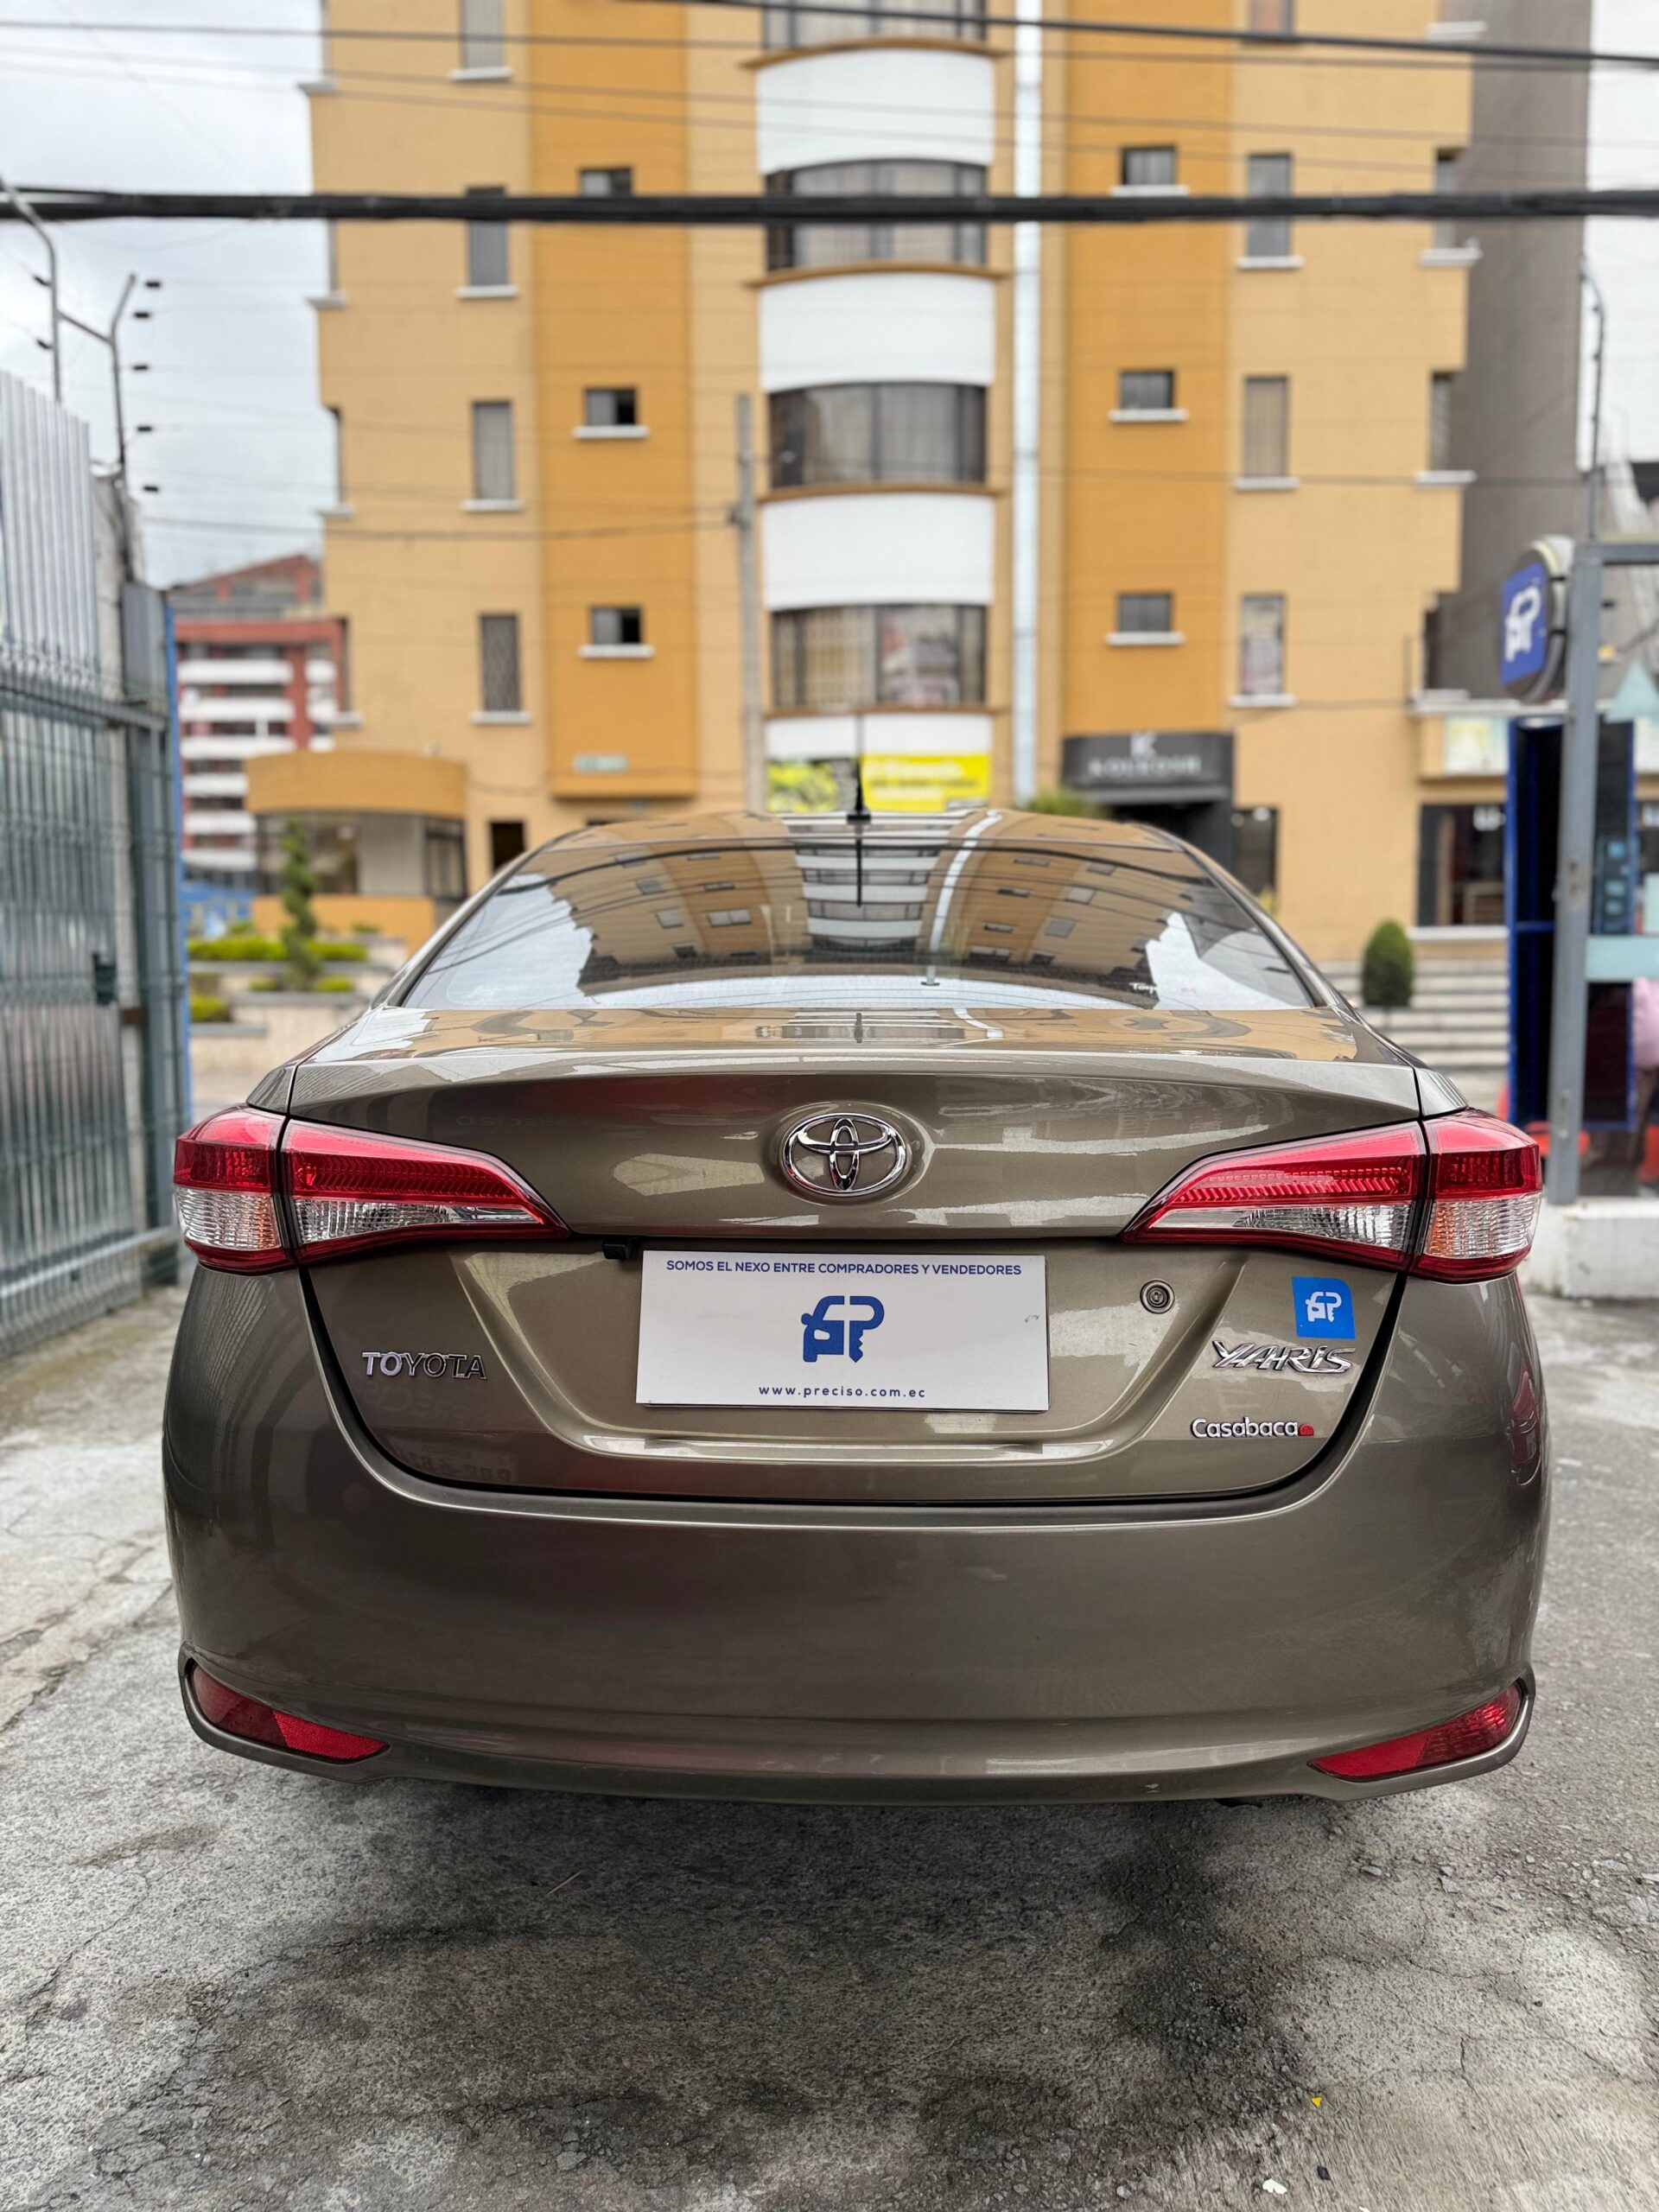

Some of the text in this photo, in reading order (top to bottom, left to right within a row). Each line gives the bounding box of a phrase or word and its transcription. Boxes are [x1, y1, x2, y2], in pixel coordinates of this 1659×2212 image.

[666, 1260, 1022, 1275] SOMOS EL NEXO ENTRE COMPRADORES Y VENDEDORES
[361, 1351, 487, 1380] TOYOTA
[1212, 1340, 1356, 1373] YARIS
[759, 1386, 925, 1398] www.preciso.com.ec
[1192, 1416, 1298, 1438] Casabaca
